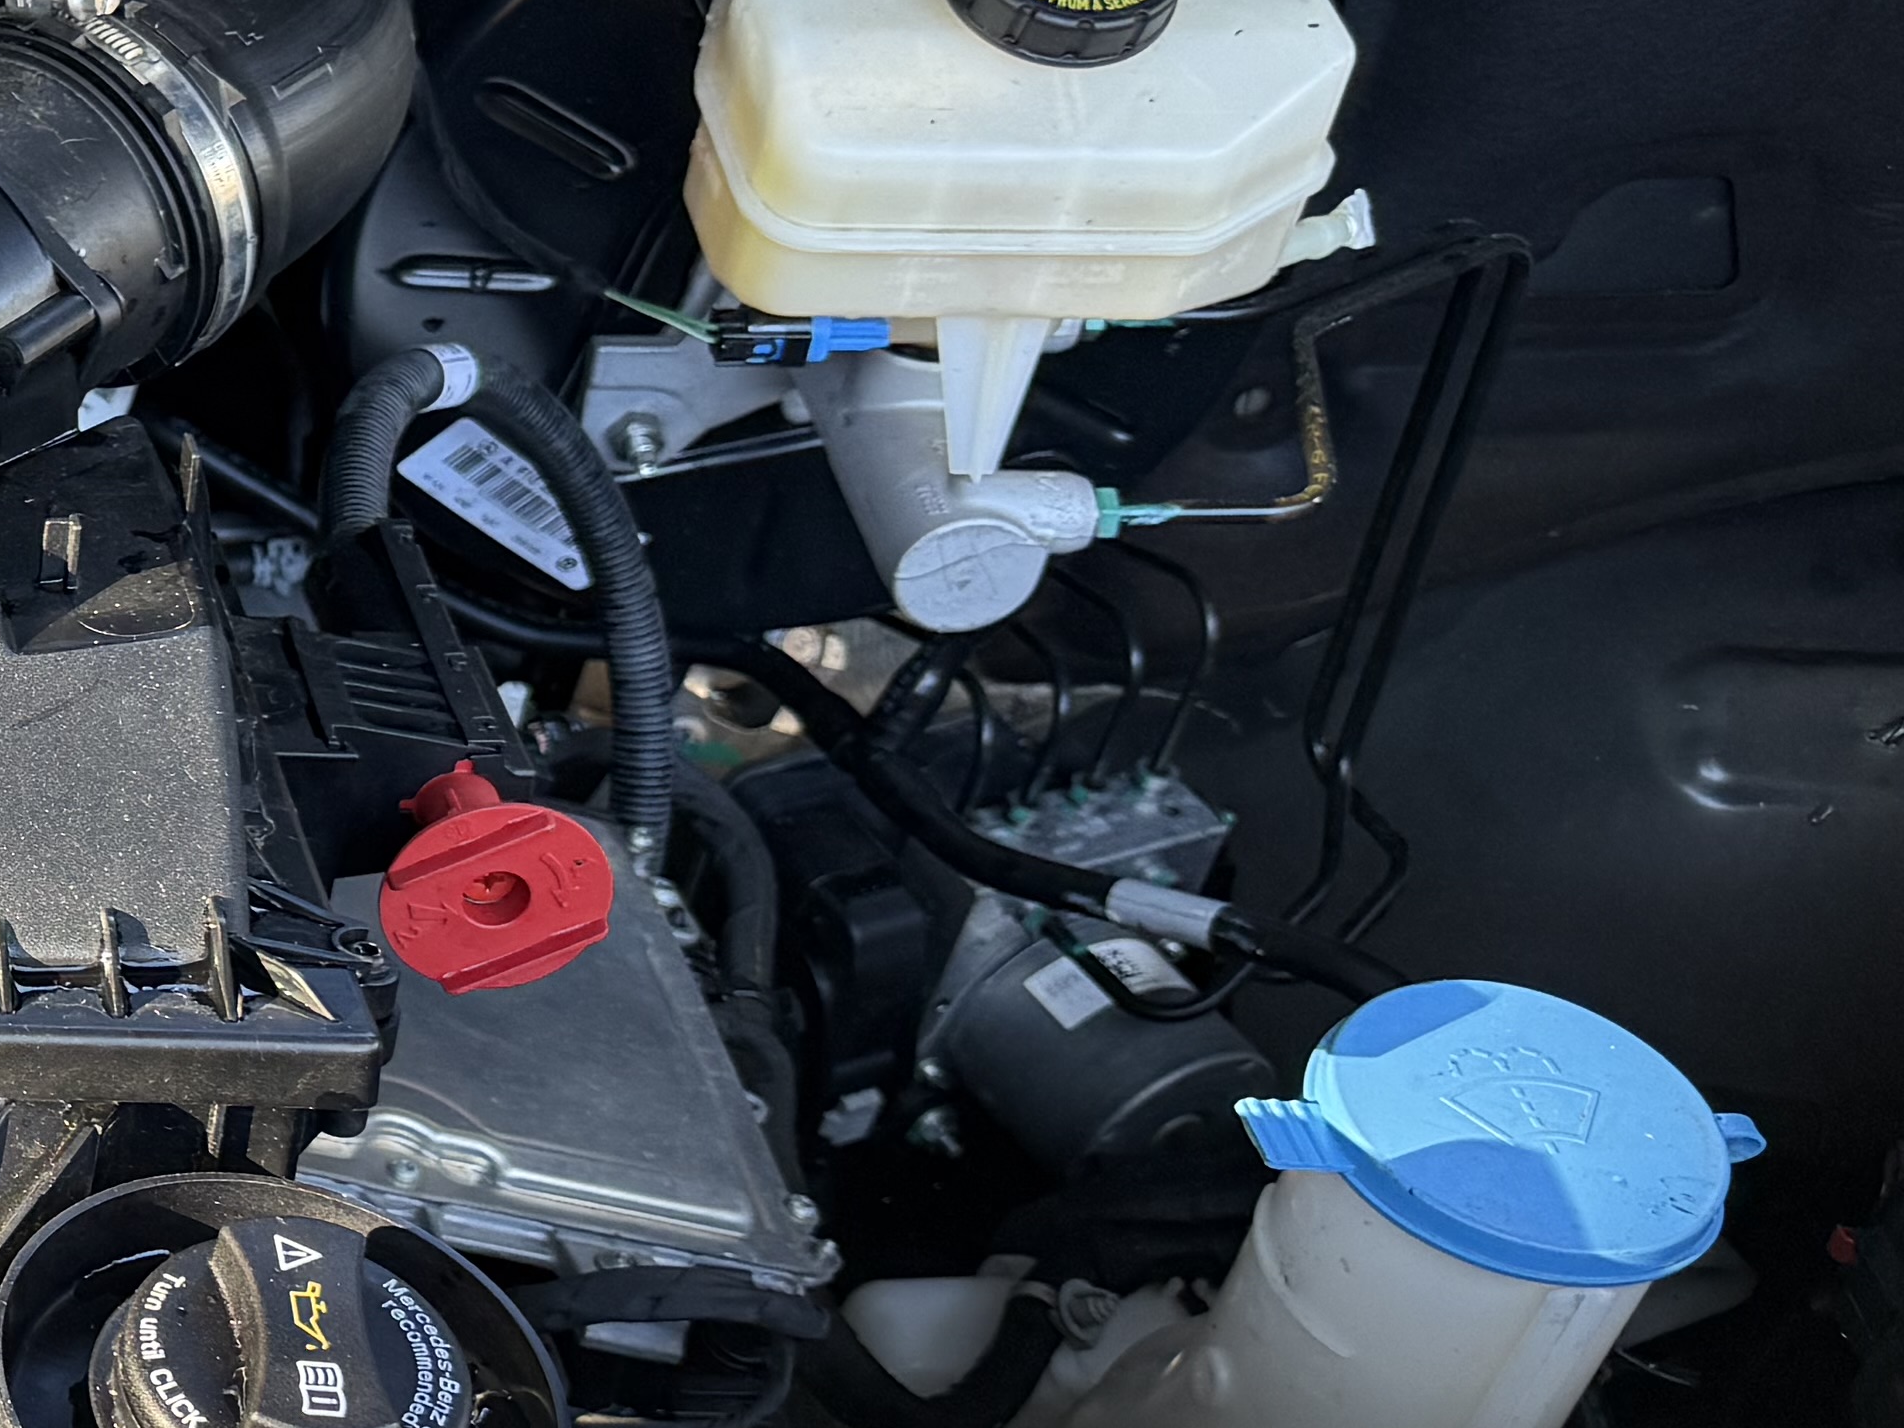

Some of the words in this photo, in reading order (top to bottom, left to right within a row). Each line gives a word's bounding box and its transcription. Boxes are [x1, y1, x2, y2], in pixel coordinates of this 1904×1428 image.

[143, 1272, 187, 1317] Turn
[138, 1316, 166, 1360] until
[382, 1278, 461, 1427] Mercedes-Benz
